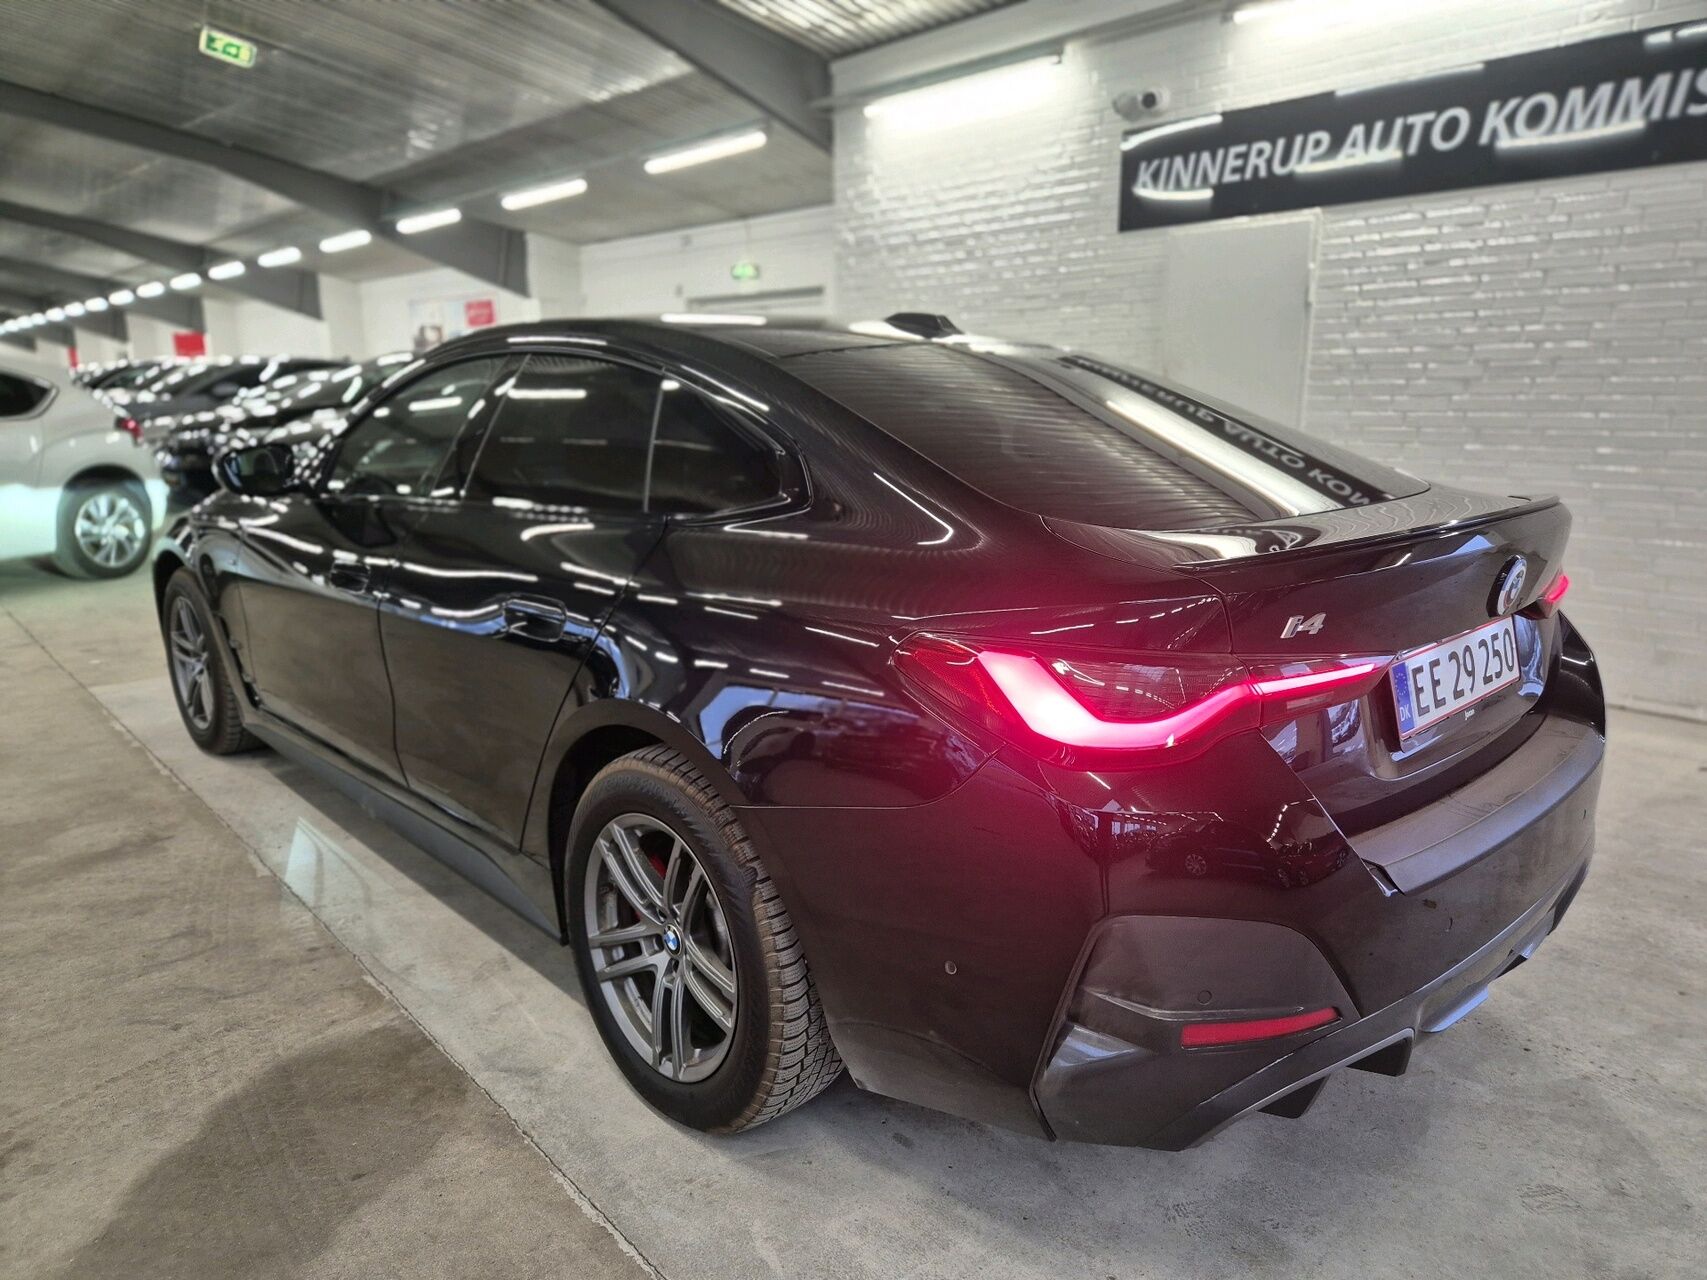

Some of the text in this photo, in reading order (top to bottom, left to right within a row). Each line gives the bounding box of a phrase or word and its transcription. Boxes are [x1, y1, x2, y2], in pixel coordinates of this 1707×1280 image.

[1136, 131, 1331, 192] KINNERUP
[1334, 106, 1471, 162] AUTO
[1280, 612, 1327, 639] i4
[1411, 627, 1515, 718] EE 29 250
[1400, 703, 1412, 722] DK
